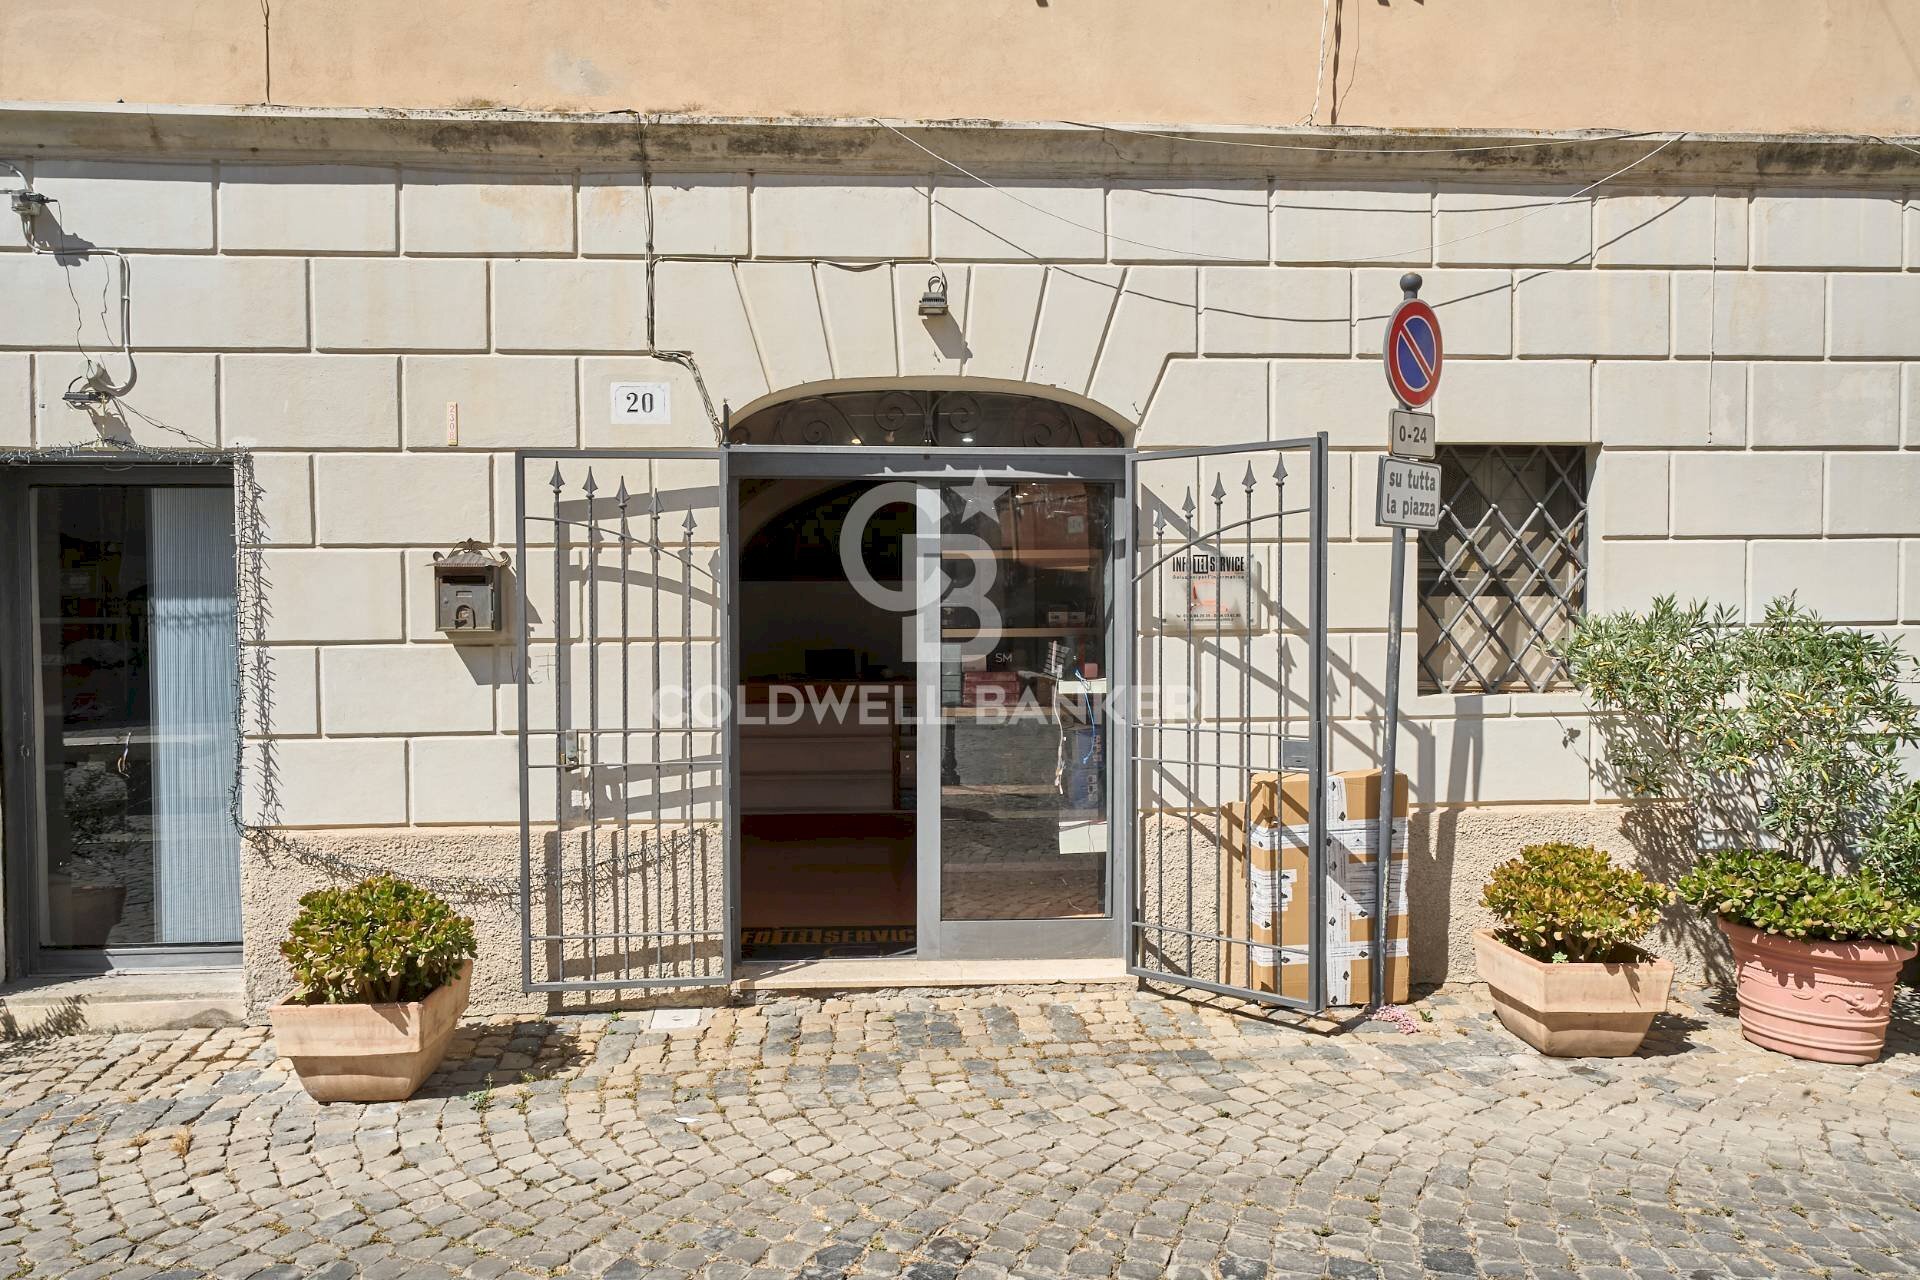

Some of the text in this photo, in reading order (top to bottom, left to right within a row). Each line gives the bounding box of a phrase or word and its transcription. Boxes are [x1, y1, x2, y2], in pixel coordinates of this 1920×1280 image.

[626, 392, 654, 413] 20
[1389, 469, 1436, 491] su tutta
[1386, 494, 1436, 518] la piazza
[1210, 557, 1244, 572] SRVICE
